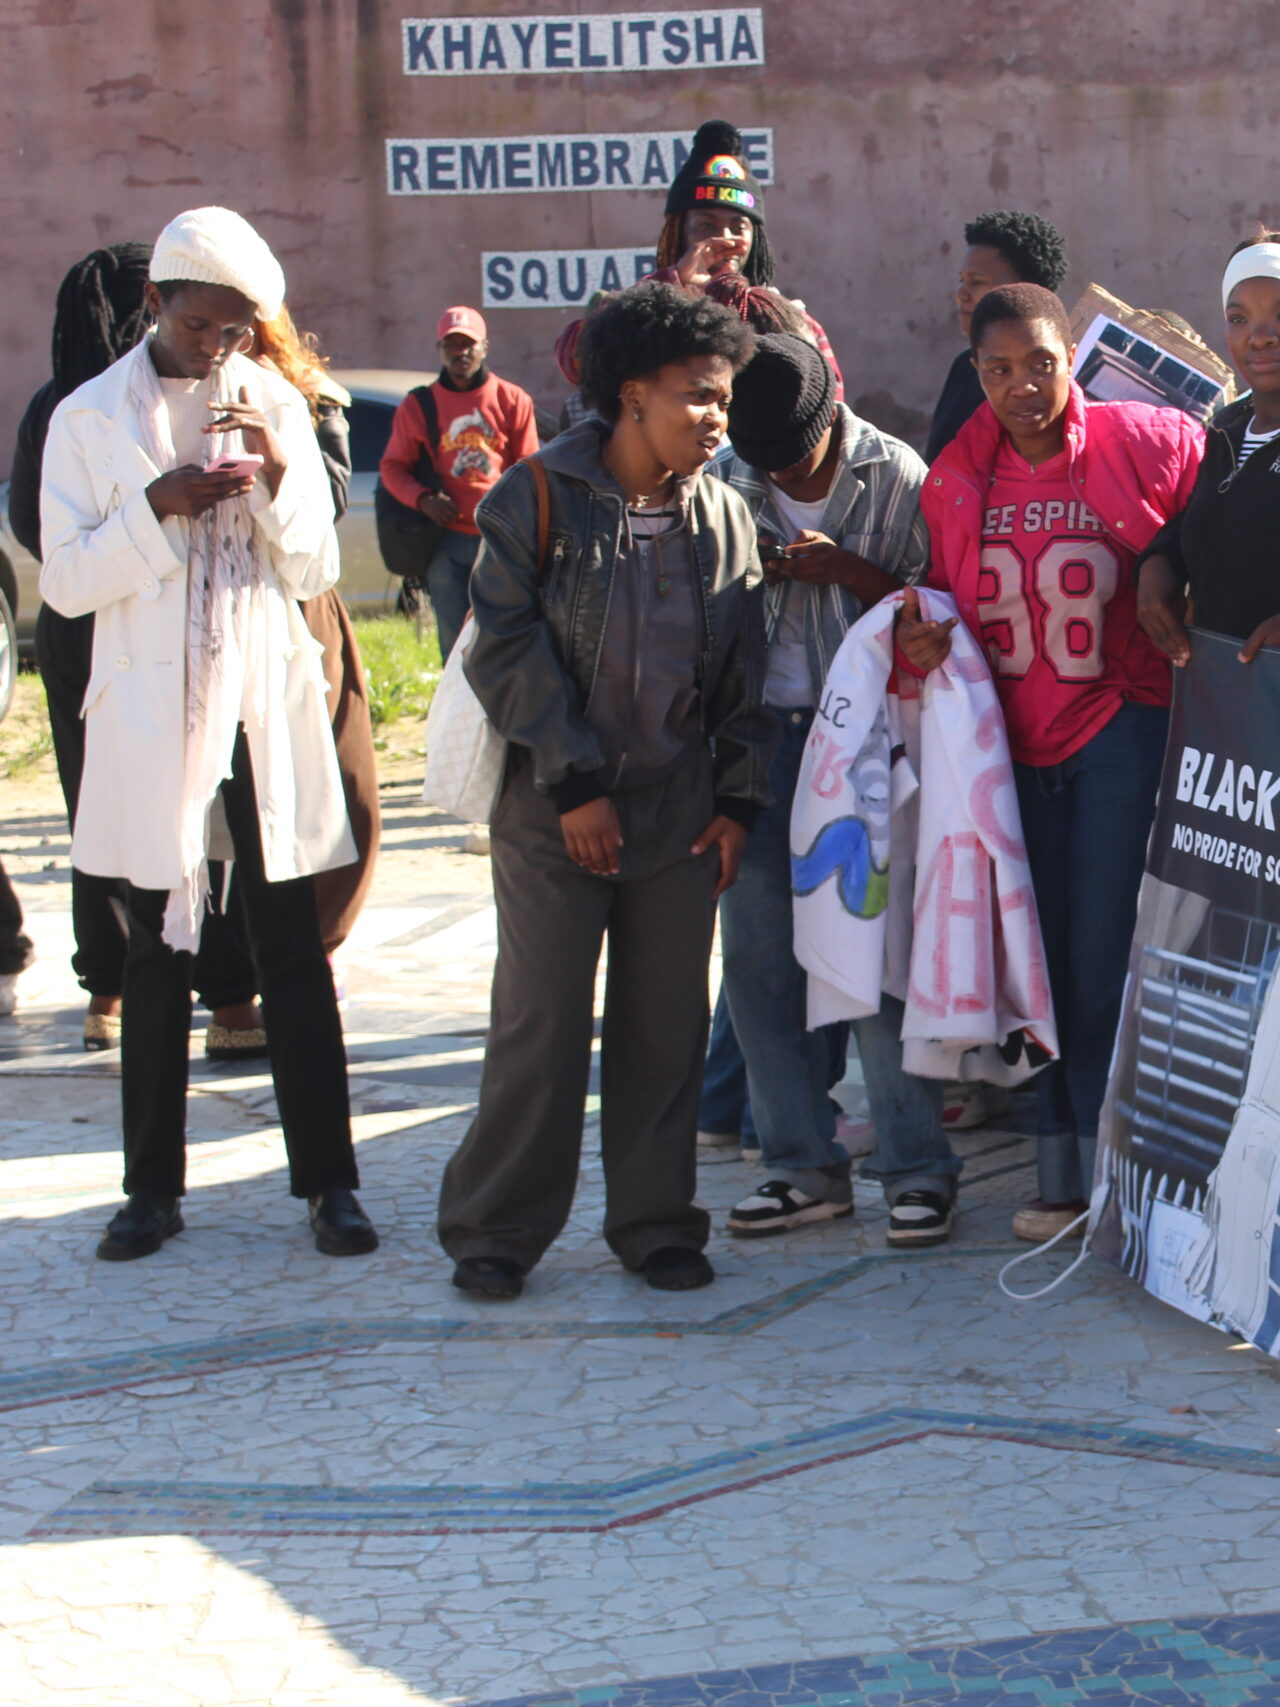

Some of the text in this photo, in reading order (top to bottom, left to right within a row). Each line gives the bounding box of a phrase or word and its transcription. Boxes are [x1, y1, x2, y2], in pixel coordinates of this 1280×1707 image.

[407, 15, 758, 71] KHAYELITSHA
[391, 134, 769, 190] REMEMBRANE
[695, 186, 755, 208] BE KIND
[1023, 500, 1108, 533] SPIR
[1171, 823, 1193, 853] NO
[1193, 832, 1237, 868] PRIDE
[1235, 843, 1263, 878] FOR
